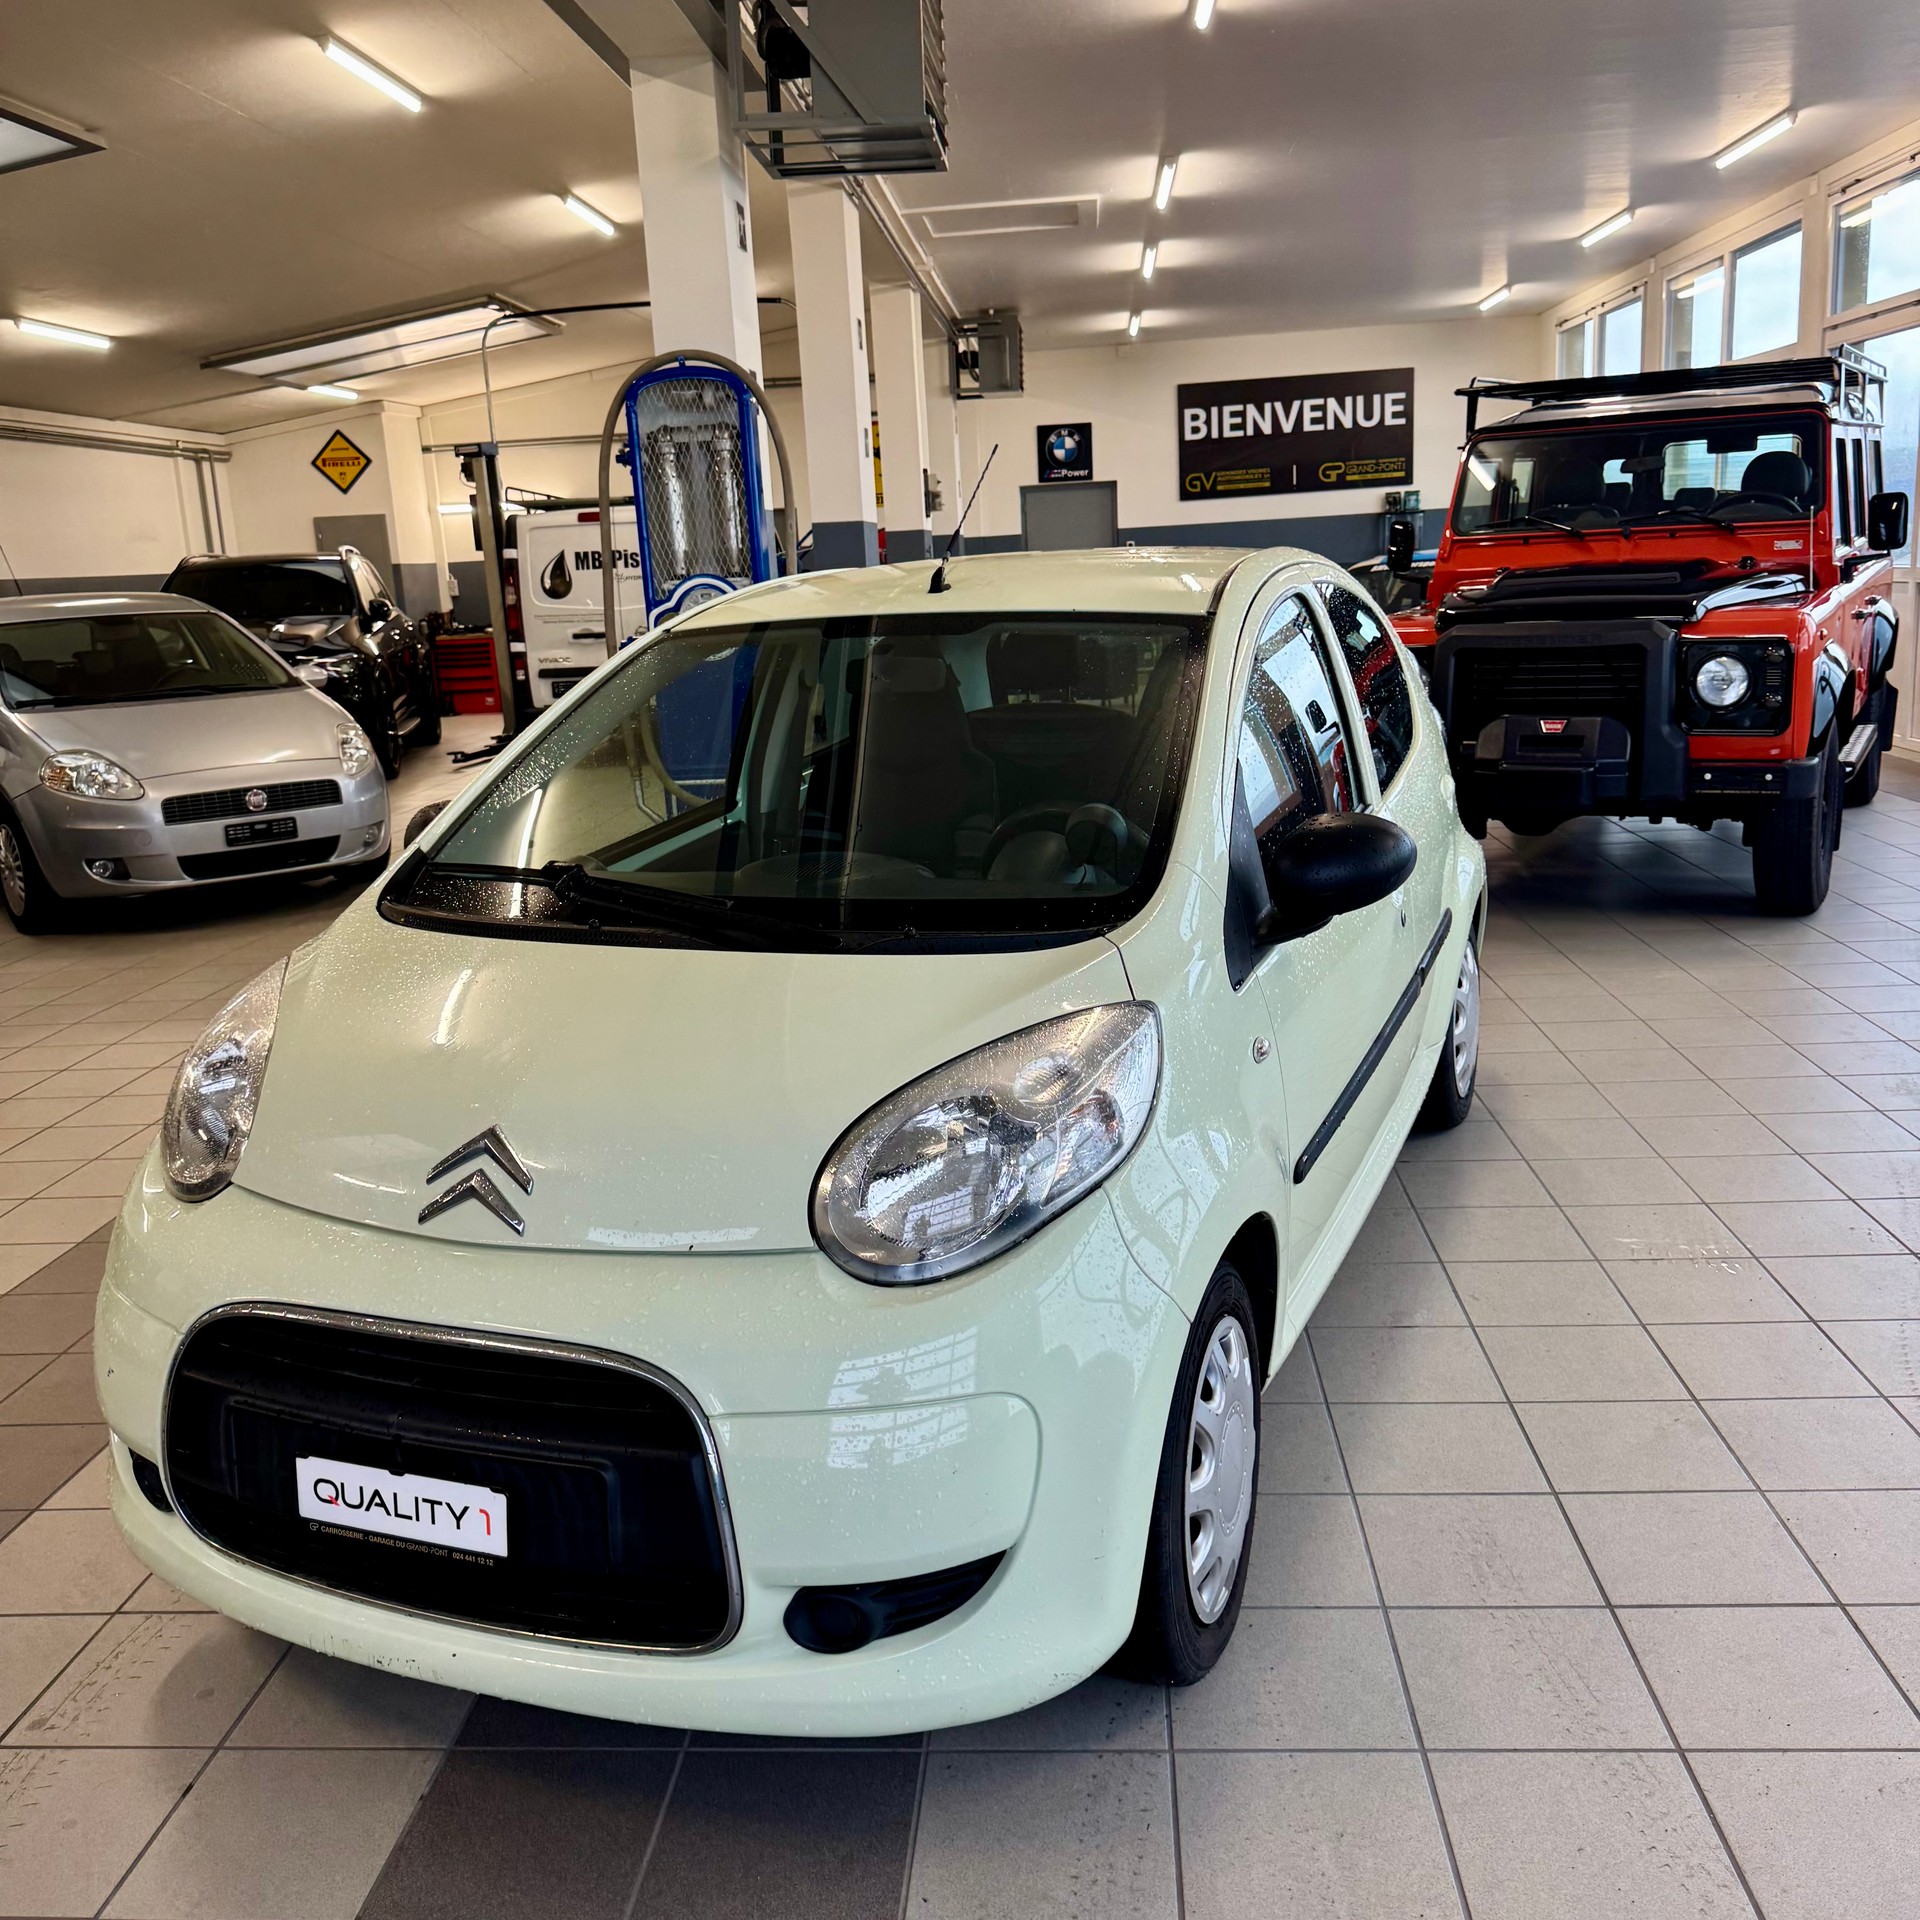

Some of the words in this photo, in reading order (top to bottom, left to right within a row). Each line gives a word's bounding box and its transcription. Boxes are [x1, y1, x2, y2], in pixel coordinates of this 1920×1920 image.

[1183, 392, 1407, 441] BIENVENUE
[1185, 472, 1217, 493] GV
[574, 551, 603, 571] MB
[313, 1477, 470, 1531] QUALITY
[320, 1525, 364, 1540] CARROSSERIE
[368, 1535, 395, 1547] GARAGE
[395, 1540, 406, 1549] DU
[452, 1551, 464, 1561] 024
[464, 1554, 476, 1563] 441
[477, 1557, 485, 1565] 12
[486, 1559, 494, 1567] 12
